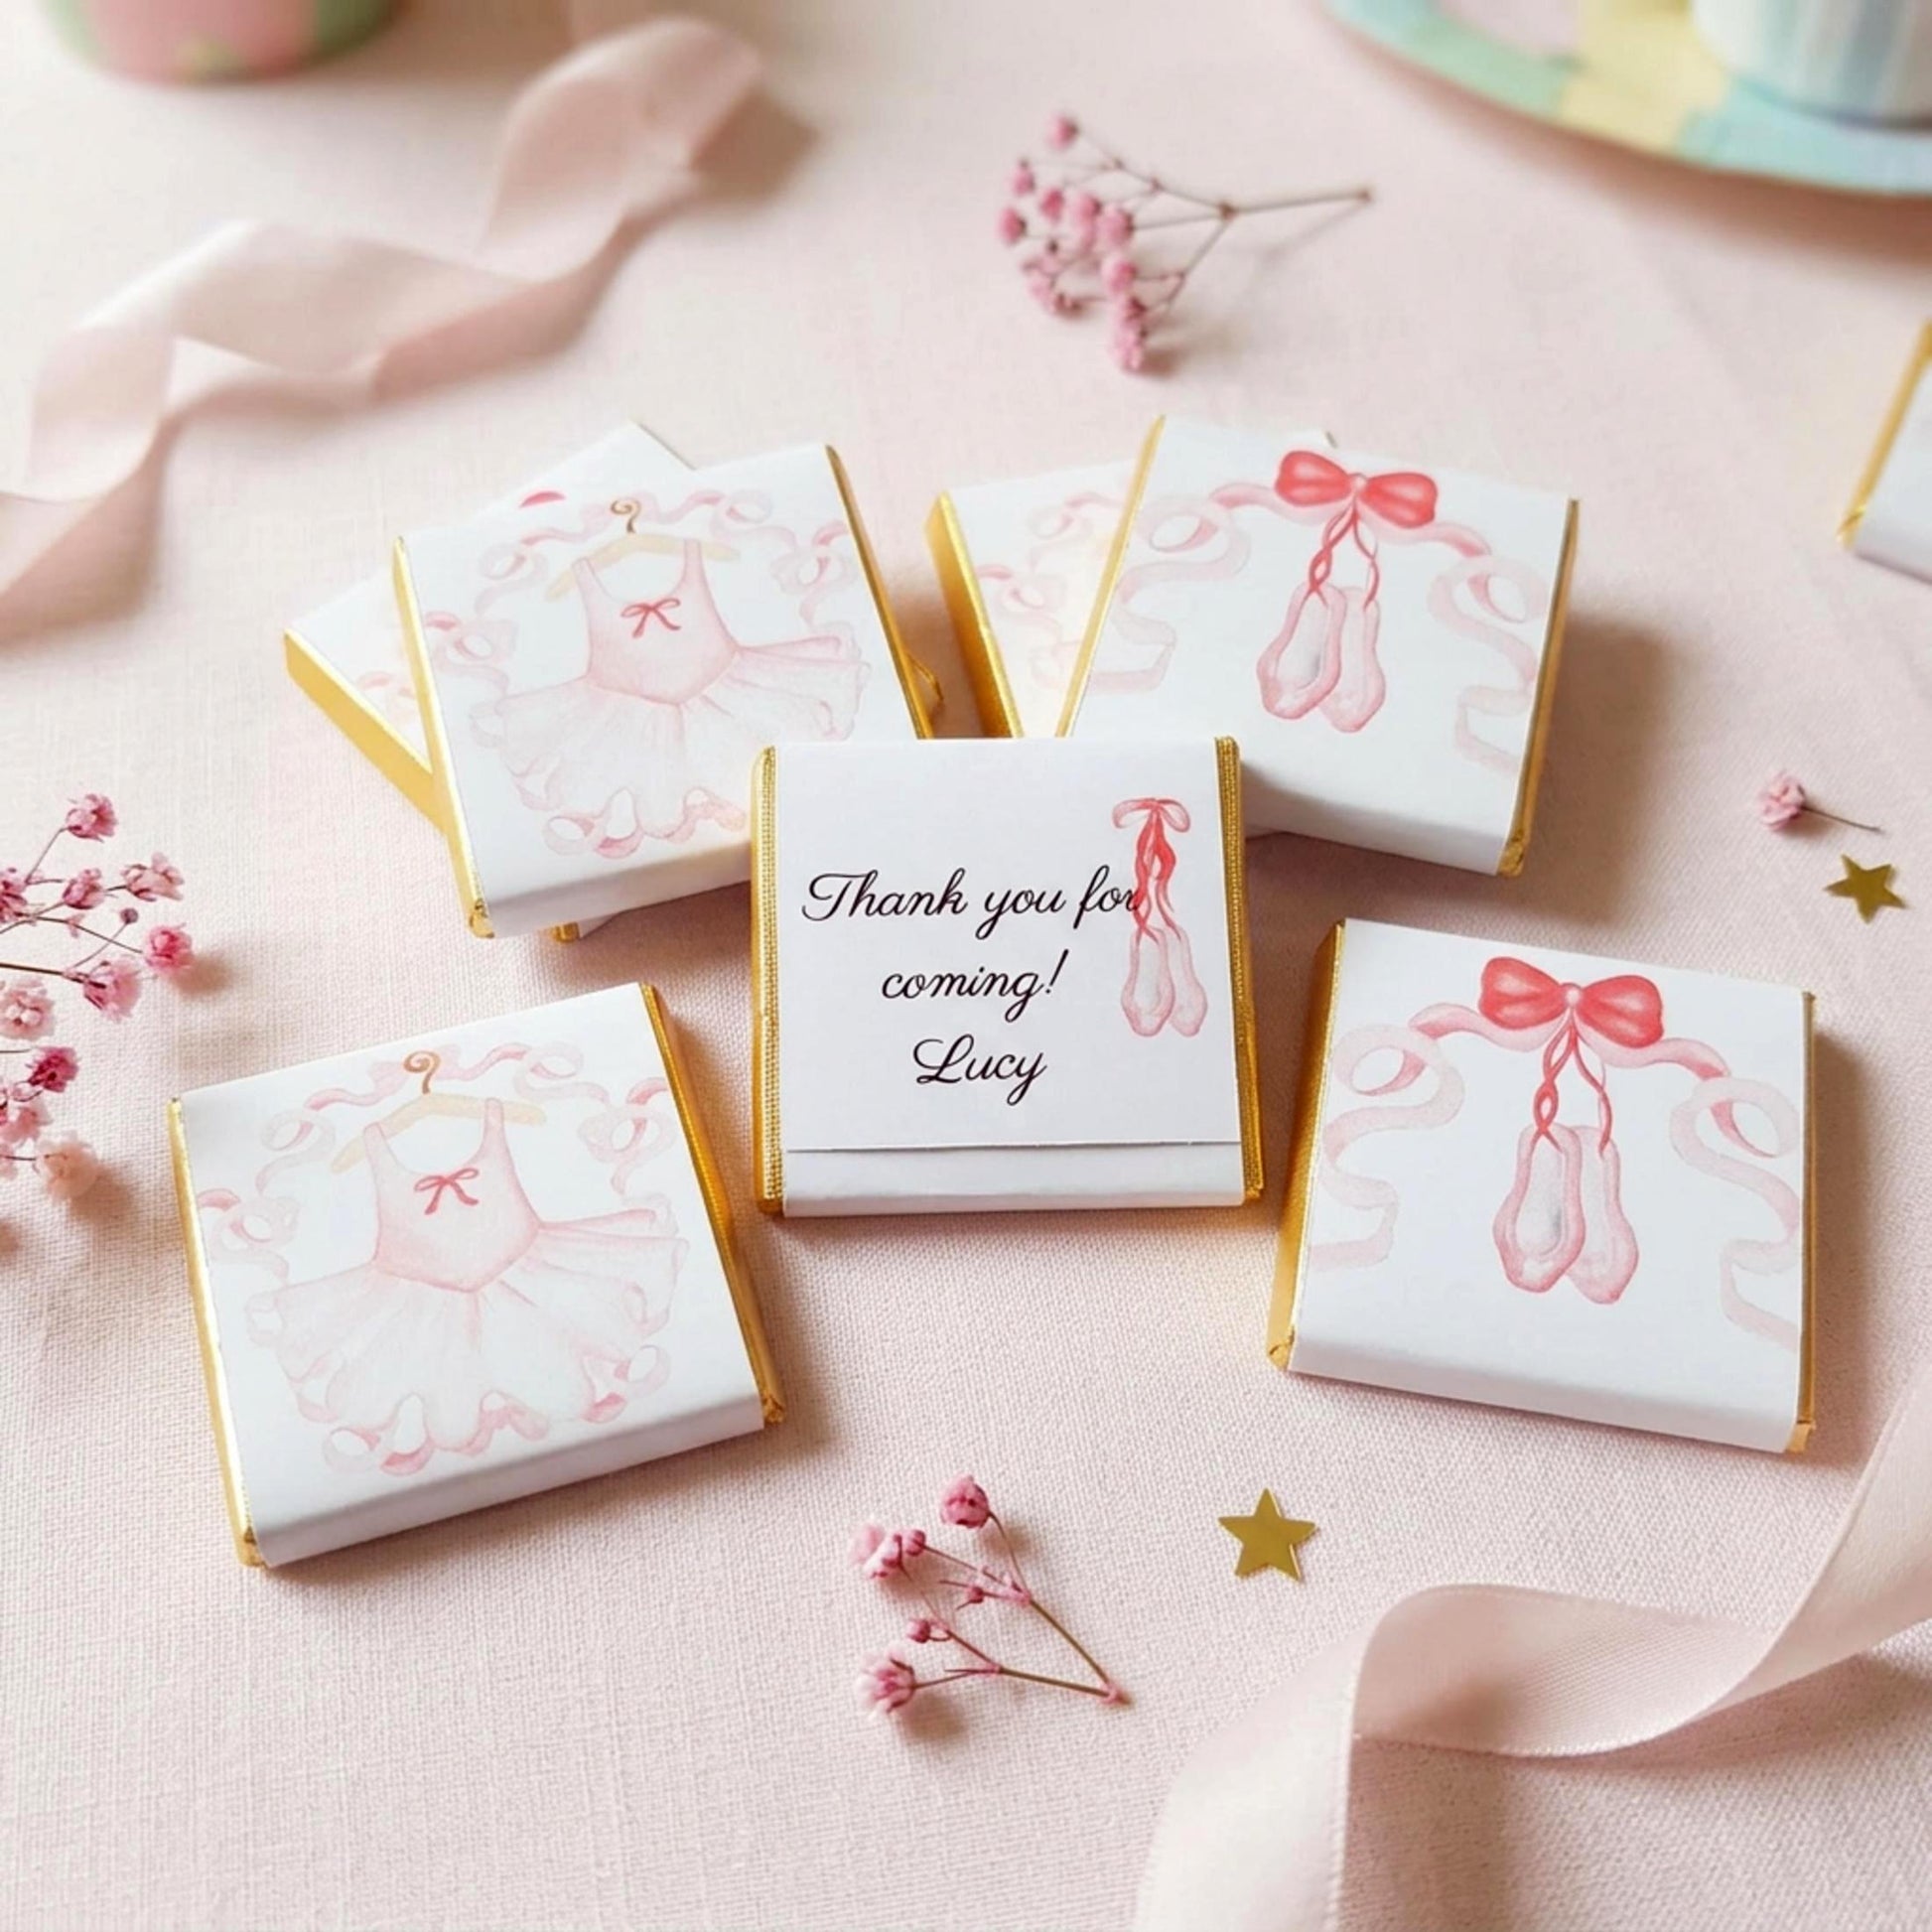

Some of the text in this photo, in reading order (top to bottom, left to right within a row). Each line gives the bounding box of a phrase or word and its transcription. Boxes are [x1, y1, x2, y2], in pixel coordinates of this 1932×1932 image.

[801, 865, 1140, 940] Thank you for
[882, 948, 1069, 1024] coming!
[912, 1034, 1047, 1106] Lucy
